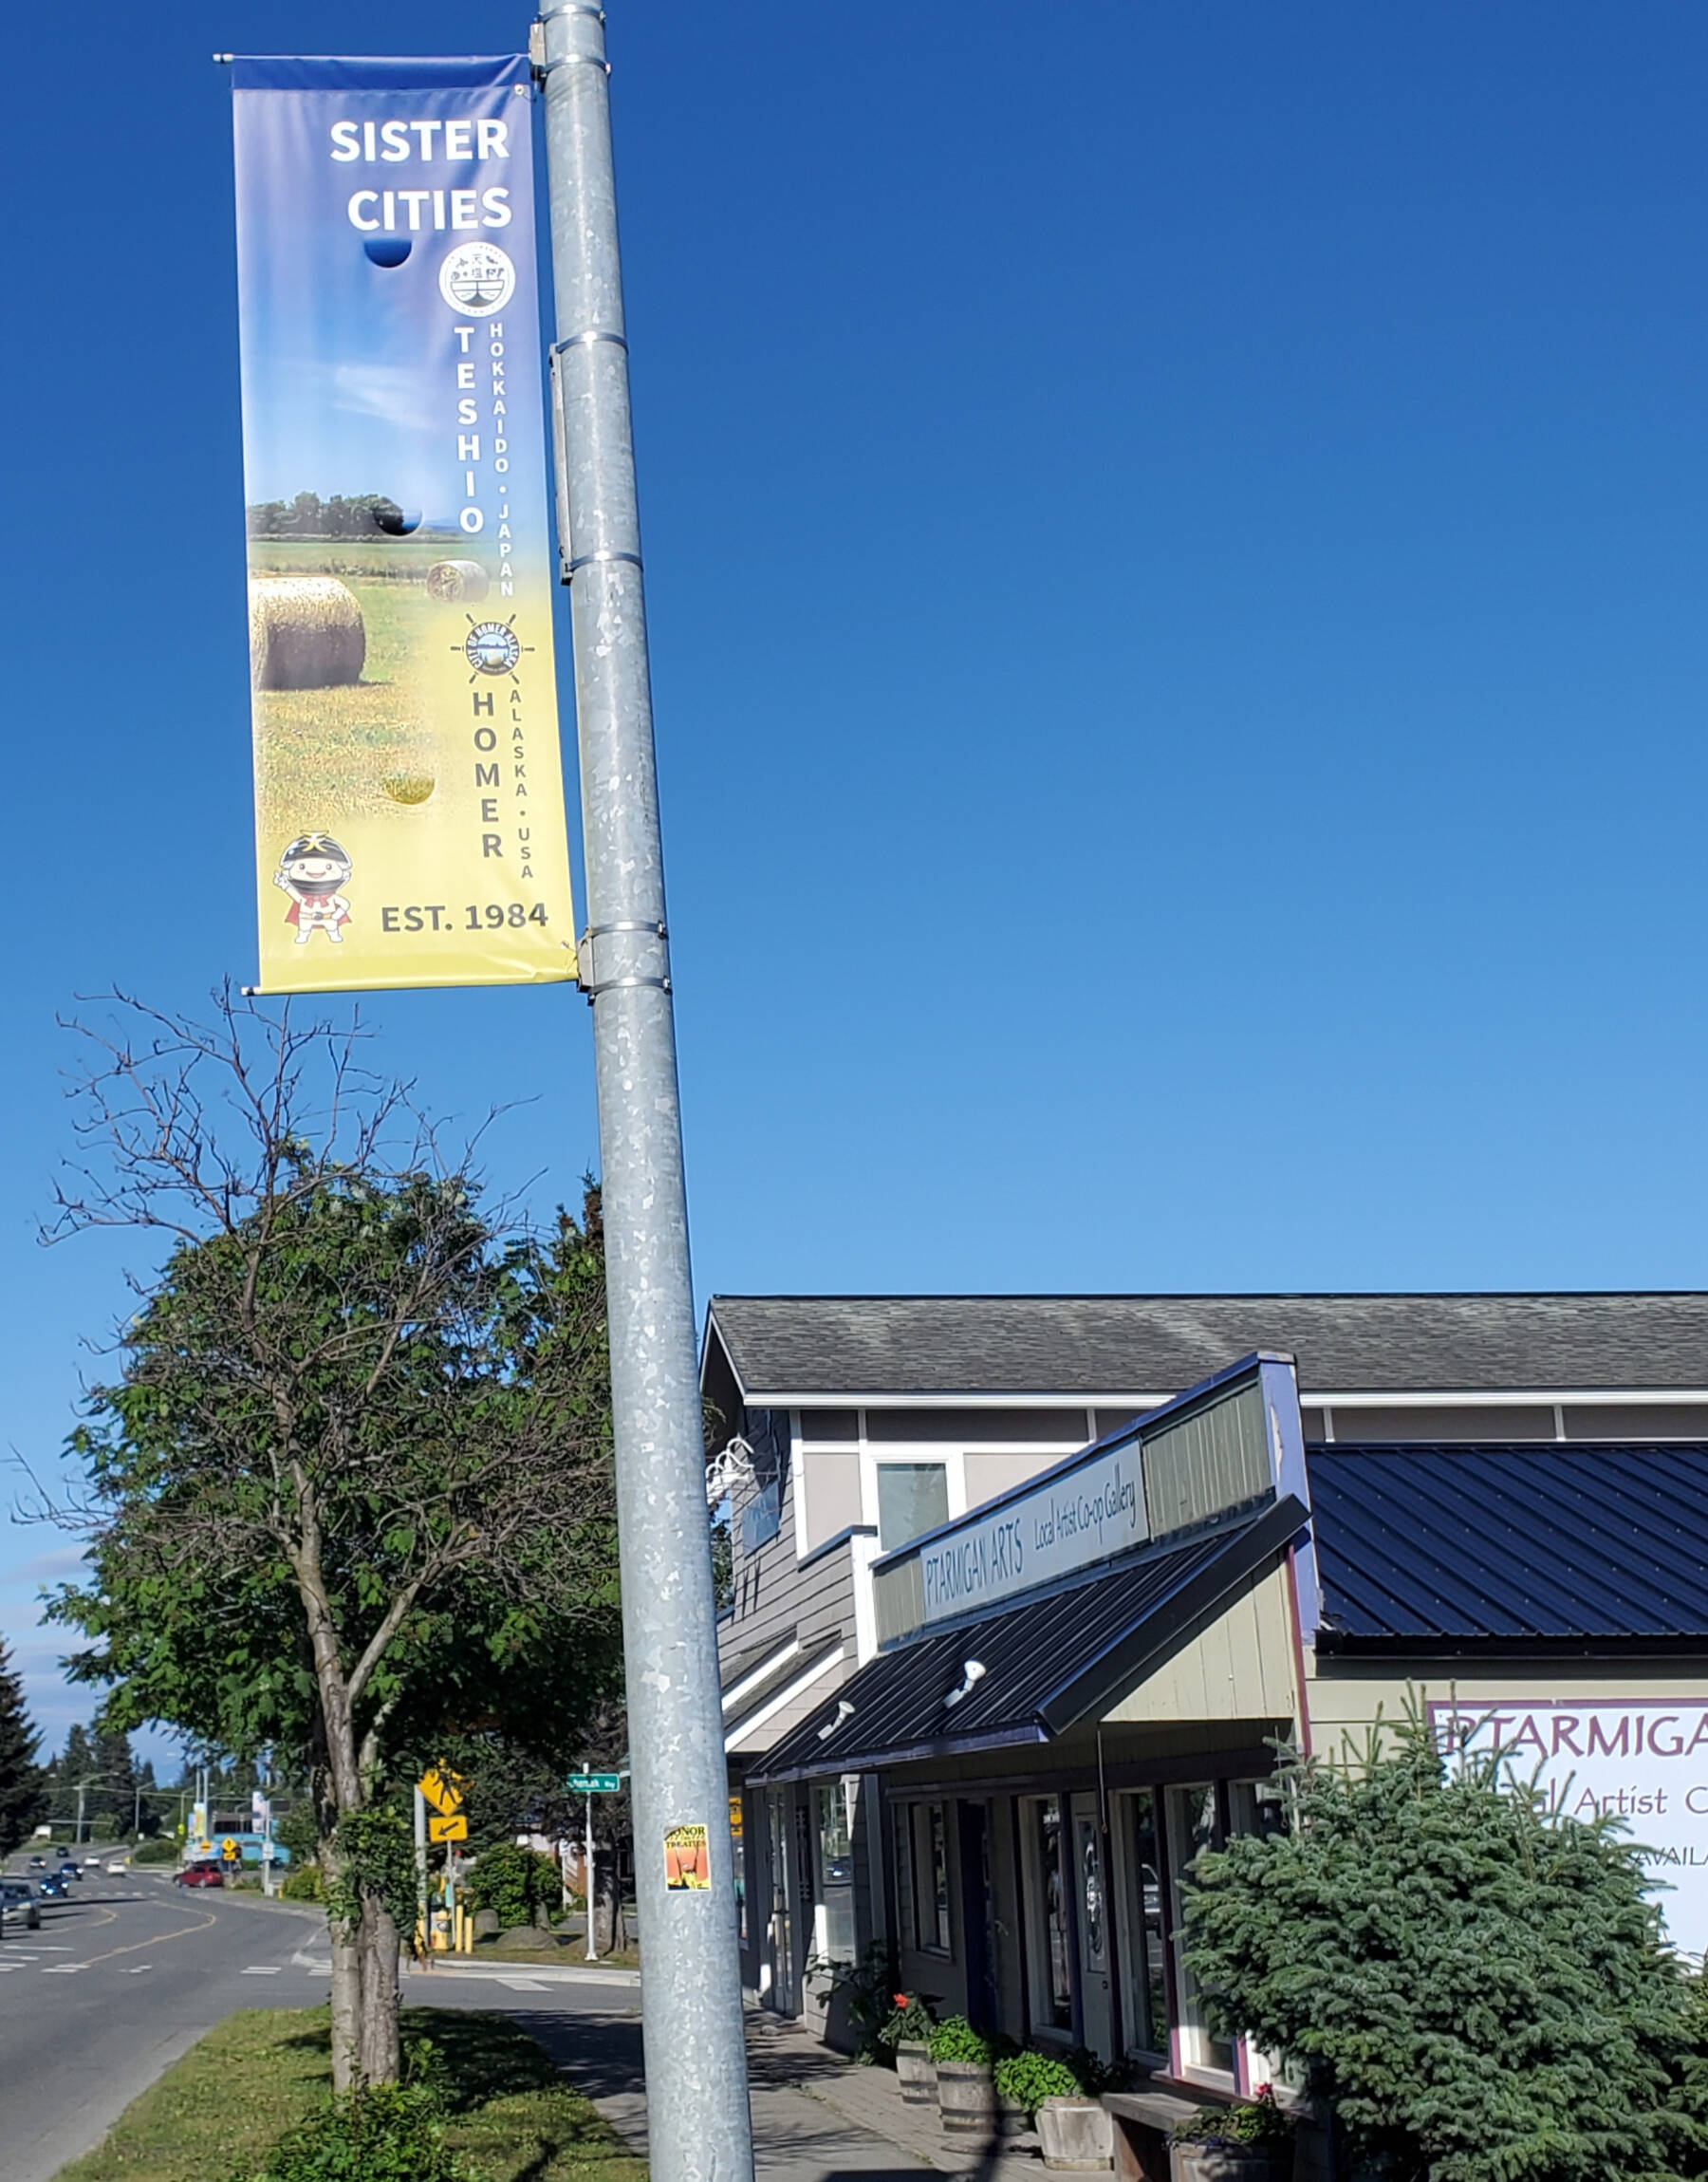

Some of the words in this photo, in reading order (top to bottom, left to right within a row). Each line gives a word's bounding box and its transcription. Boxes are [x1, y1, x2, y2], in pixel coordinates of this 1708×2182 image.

[329, 118, 511, 163] SISTER
[347, 187, 512, 232] CITIES
[454, 326, 484, 533] TESHIO
[490, 323, 509, 473] HOKKAIDO
[498, 504, 513, 596] JAPAN
[474, 623, 507, 637] HOMER
[473, 692, 503, 858] HOMER
[510, 689, 528, 796] ALASKA
[518, 828, 533, 879] USA
[381, 905, 453, 932] EST.
[465, 903, 548, 930] 1984
[1034, 1498, 1055, 1550] Local
[1055, 1501, 1077, 1539] Artist
[1078, 1495, 1104, 1546] Co-op
[1105, 1463, 1135, 1529] Gallery
[925, 1533, 987, 1608] PTARMIGAN
[992, 1518, 1023, 1582] ARTS
[1573, 1785, 1668, 1815] Artist
